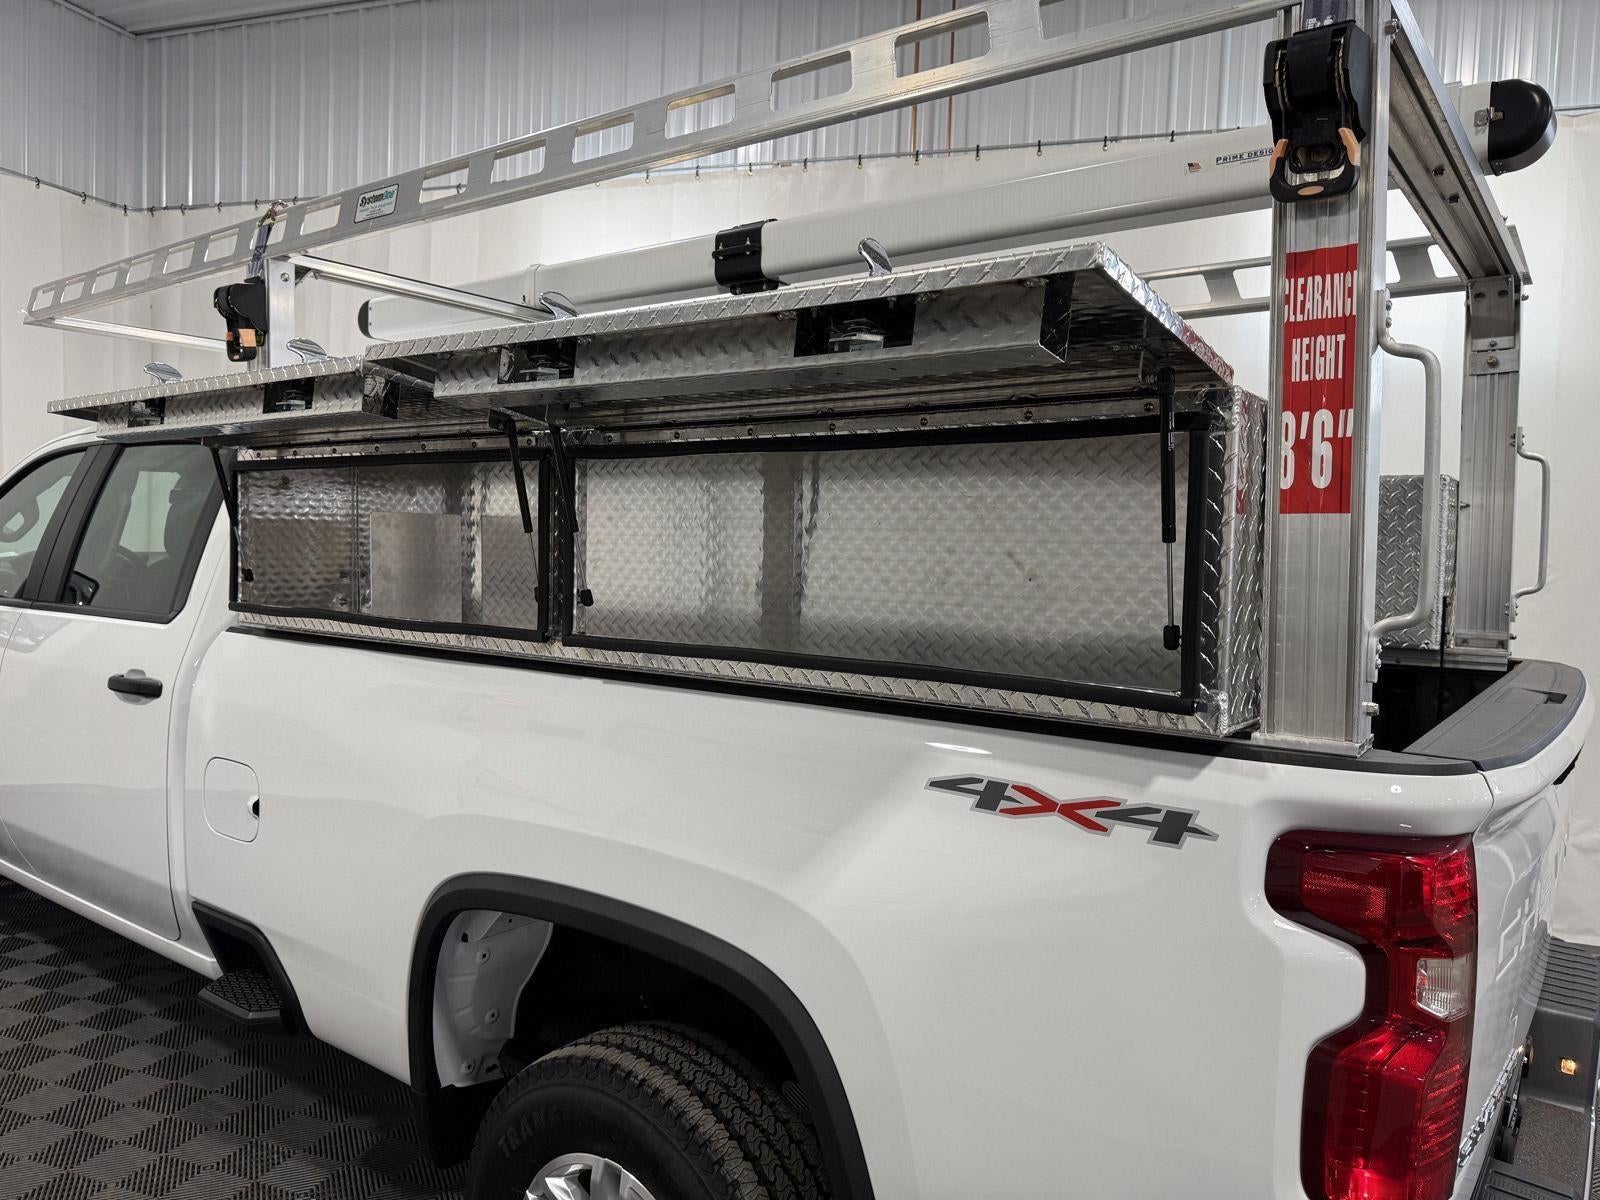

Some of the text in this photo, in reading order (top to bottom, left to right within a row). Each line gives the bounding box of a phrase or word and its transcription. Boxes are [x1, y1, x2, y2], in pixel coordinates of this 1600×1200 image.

[1216, 154, 1245, 163] PRIME
[1247, 148, 1274, 157] DESIG
[1291, 333, 1346, 382] HEIGHT
